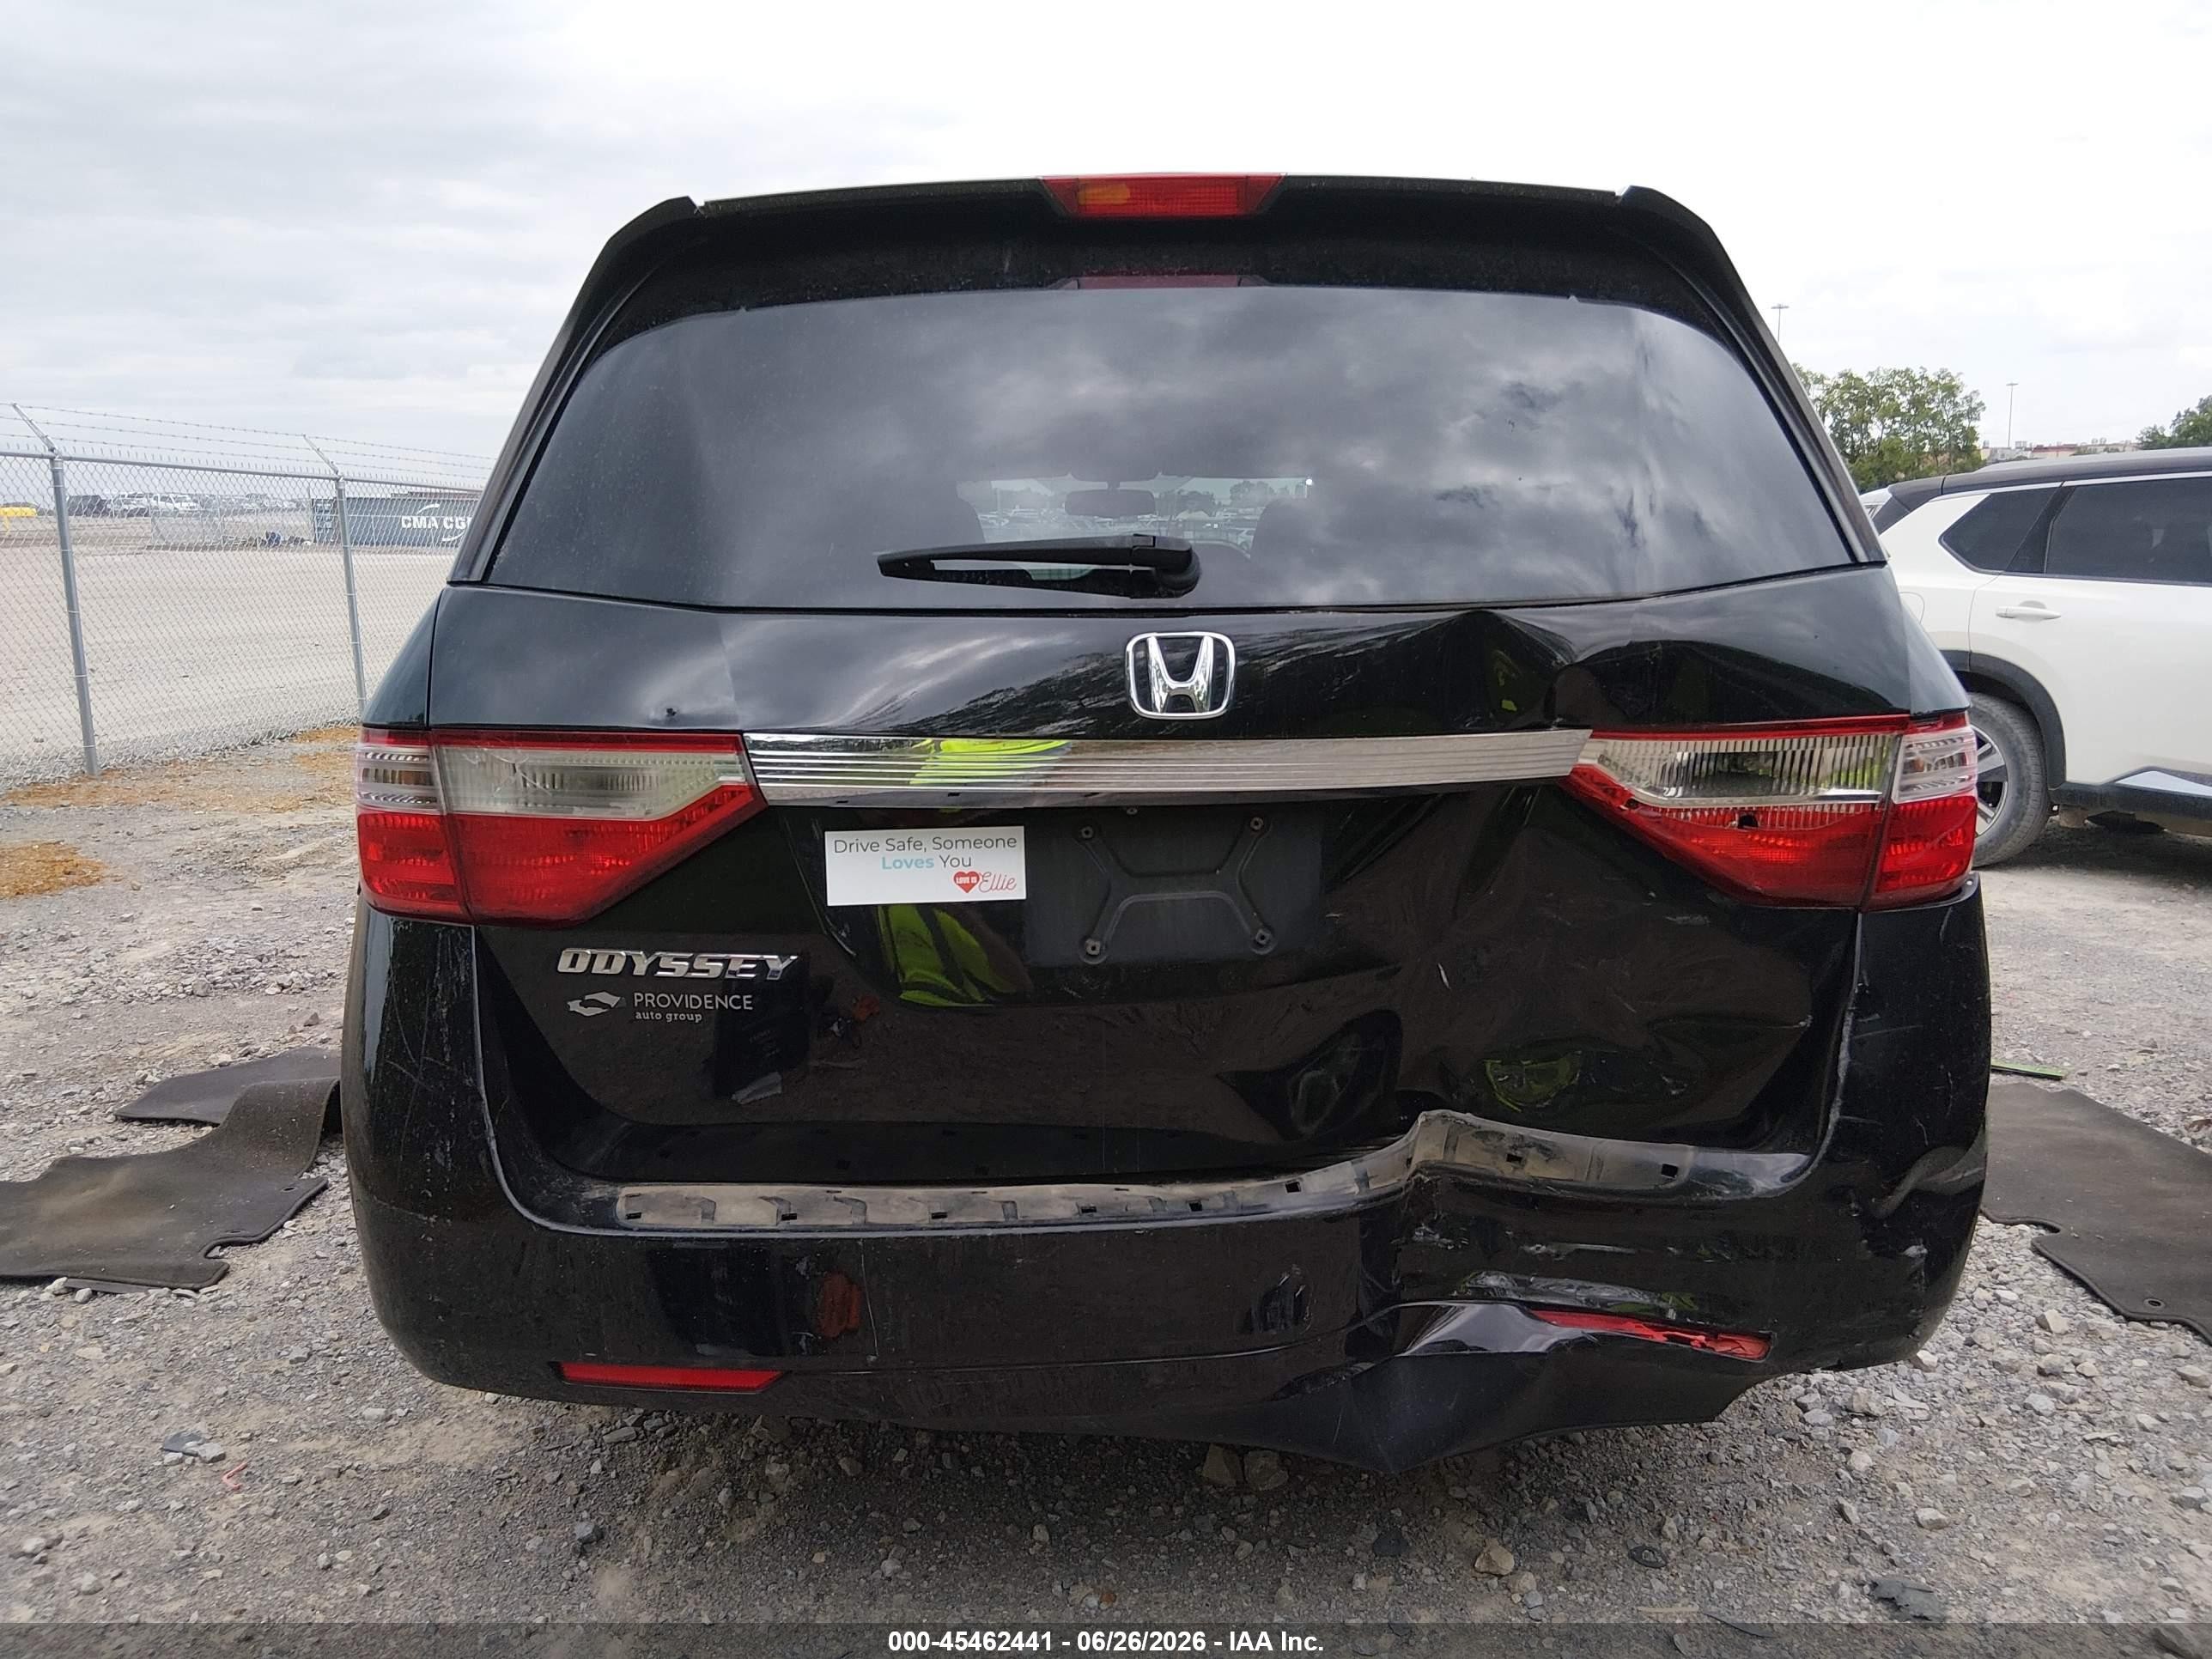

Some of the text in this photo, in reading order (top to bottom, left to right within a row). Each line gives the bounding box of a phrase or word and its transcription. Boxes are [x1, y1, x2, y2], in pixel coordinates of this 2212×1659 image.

[401, 516, 439, 529] CMA
[834, 836, 1018, 854] Drive Safe, Someone
[882, 854, 972, 870] Loves You
[979, 871, 1018, 893] Ellie
[557, 946, 799, 981] ODYSSEY
[633, 992, 754, 1011] PROVIDENCE
[635, 1011, 702, 1024] auto group
